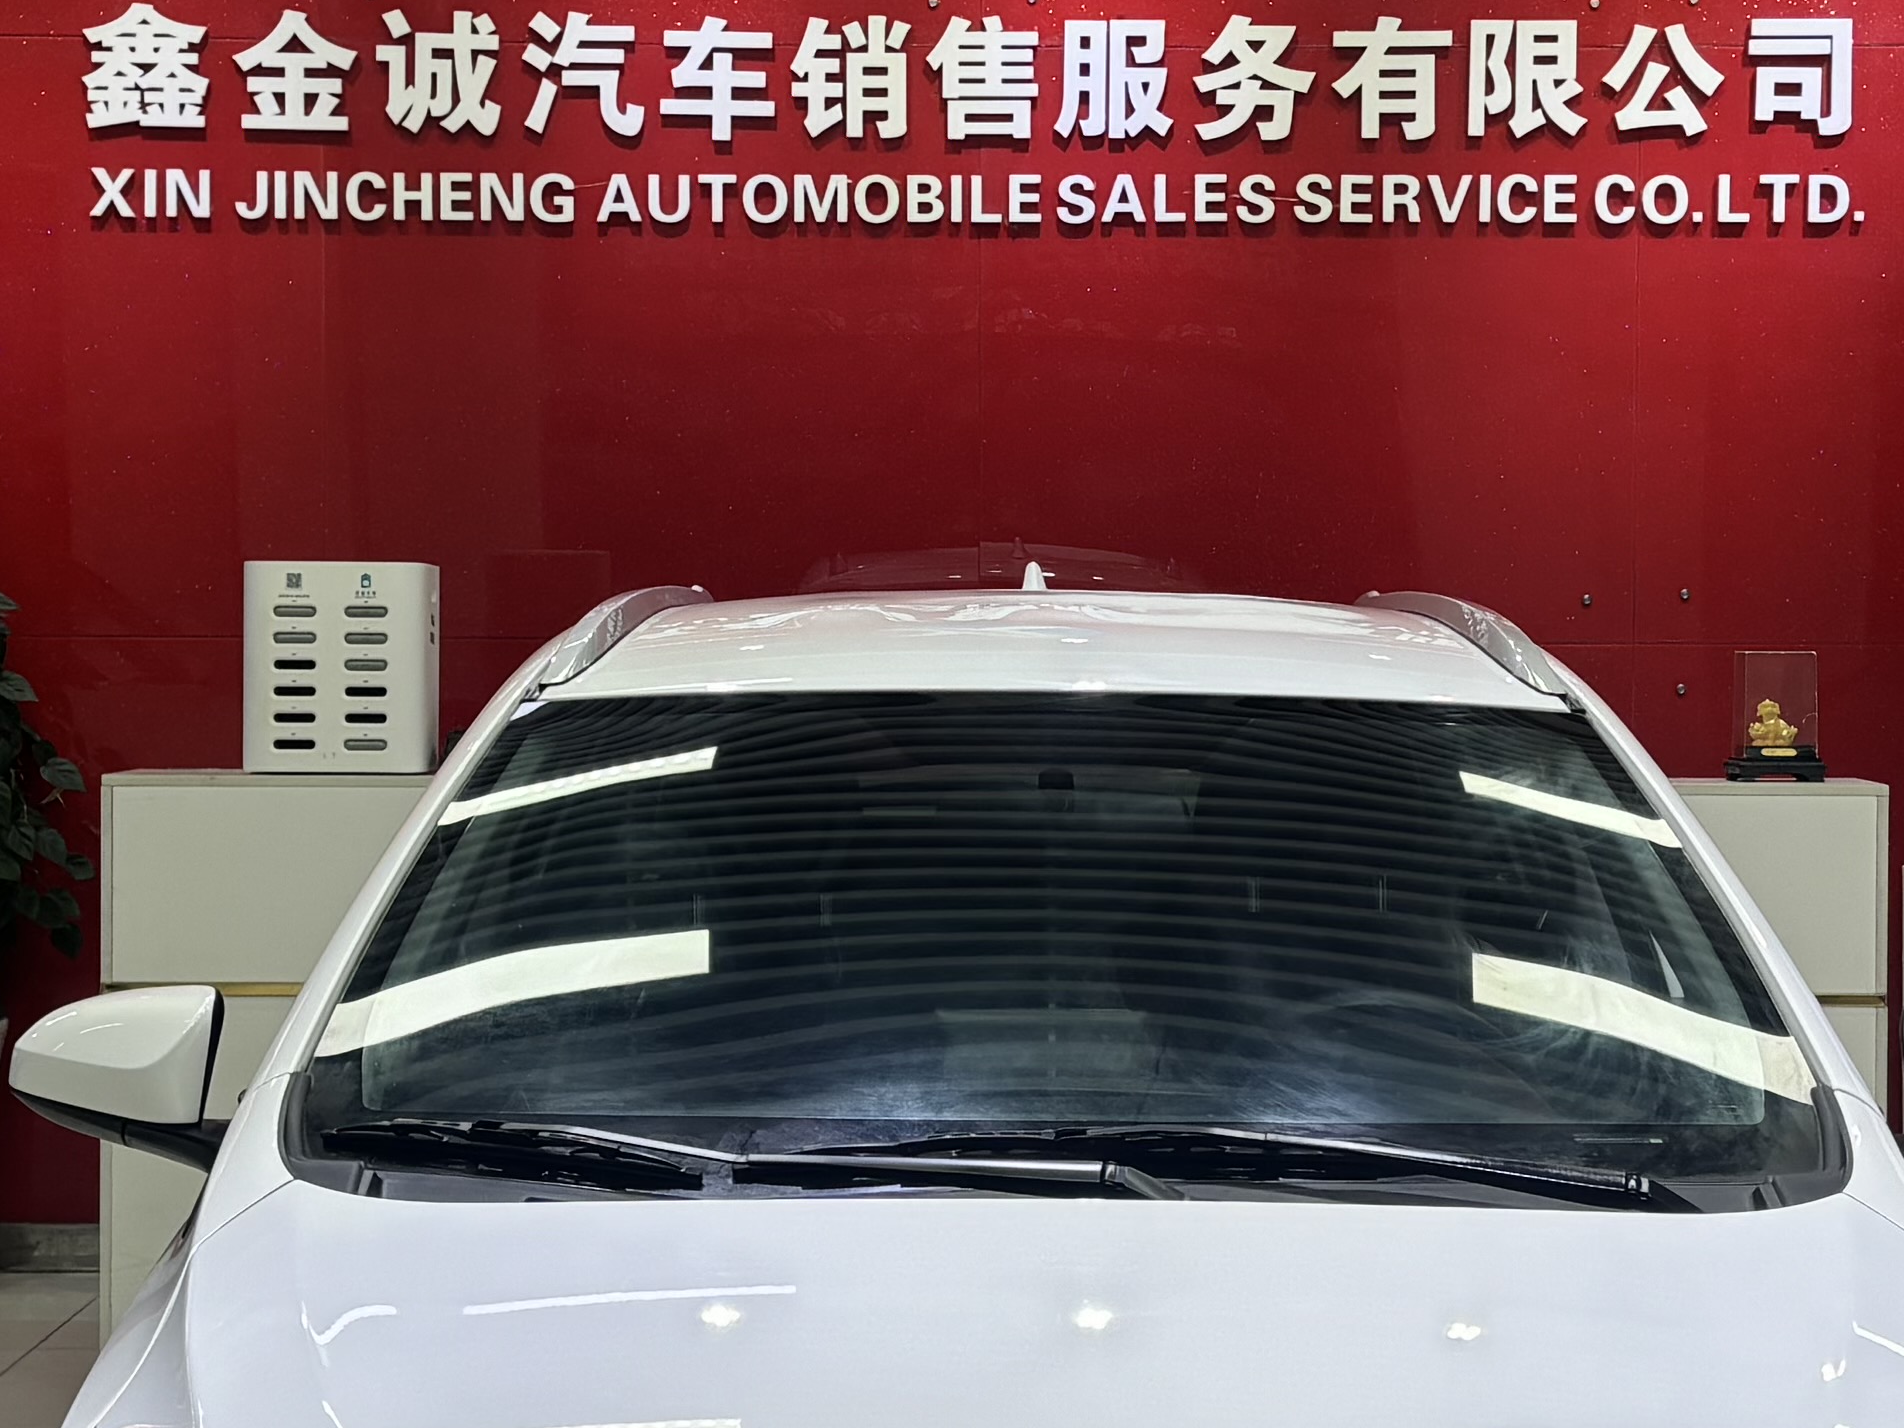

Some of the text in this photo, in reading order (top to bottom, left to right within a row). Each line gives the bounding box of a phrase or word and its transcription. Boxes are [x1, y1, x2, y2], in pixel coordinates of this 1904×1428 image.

[82, 2, 1854, 142] 鑫金诚汽车销售服务有限公司
[89, 167, 212, 222] XIN
[235, 170, 576, 224] JINCHENG
[596, 172, 1042, 226] AUTOMOBILE
[1056, 173, 1277, 226] SALES
[1295, 173, 1578, 226] SERVICE
